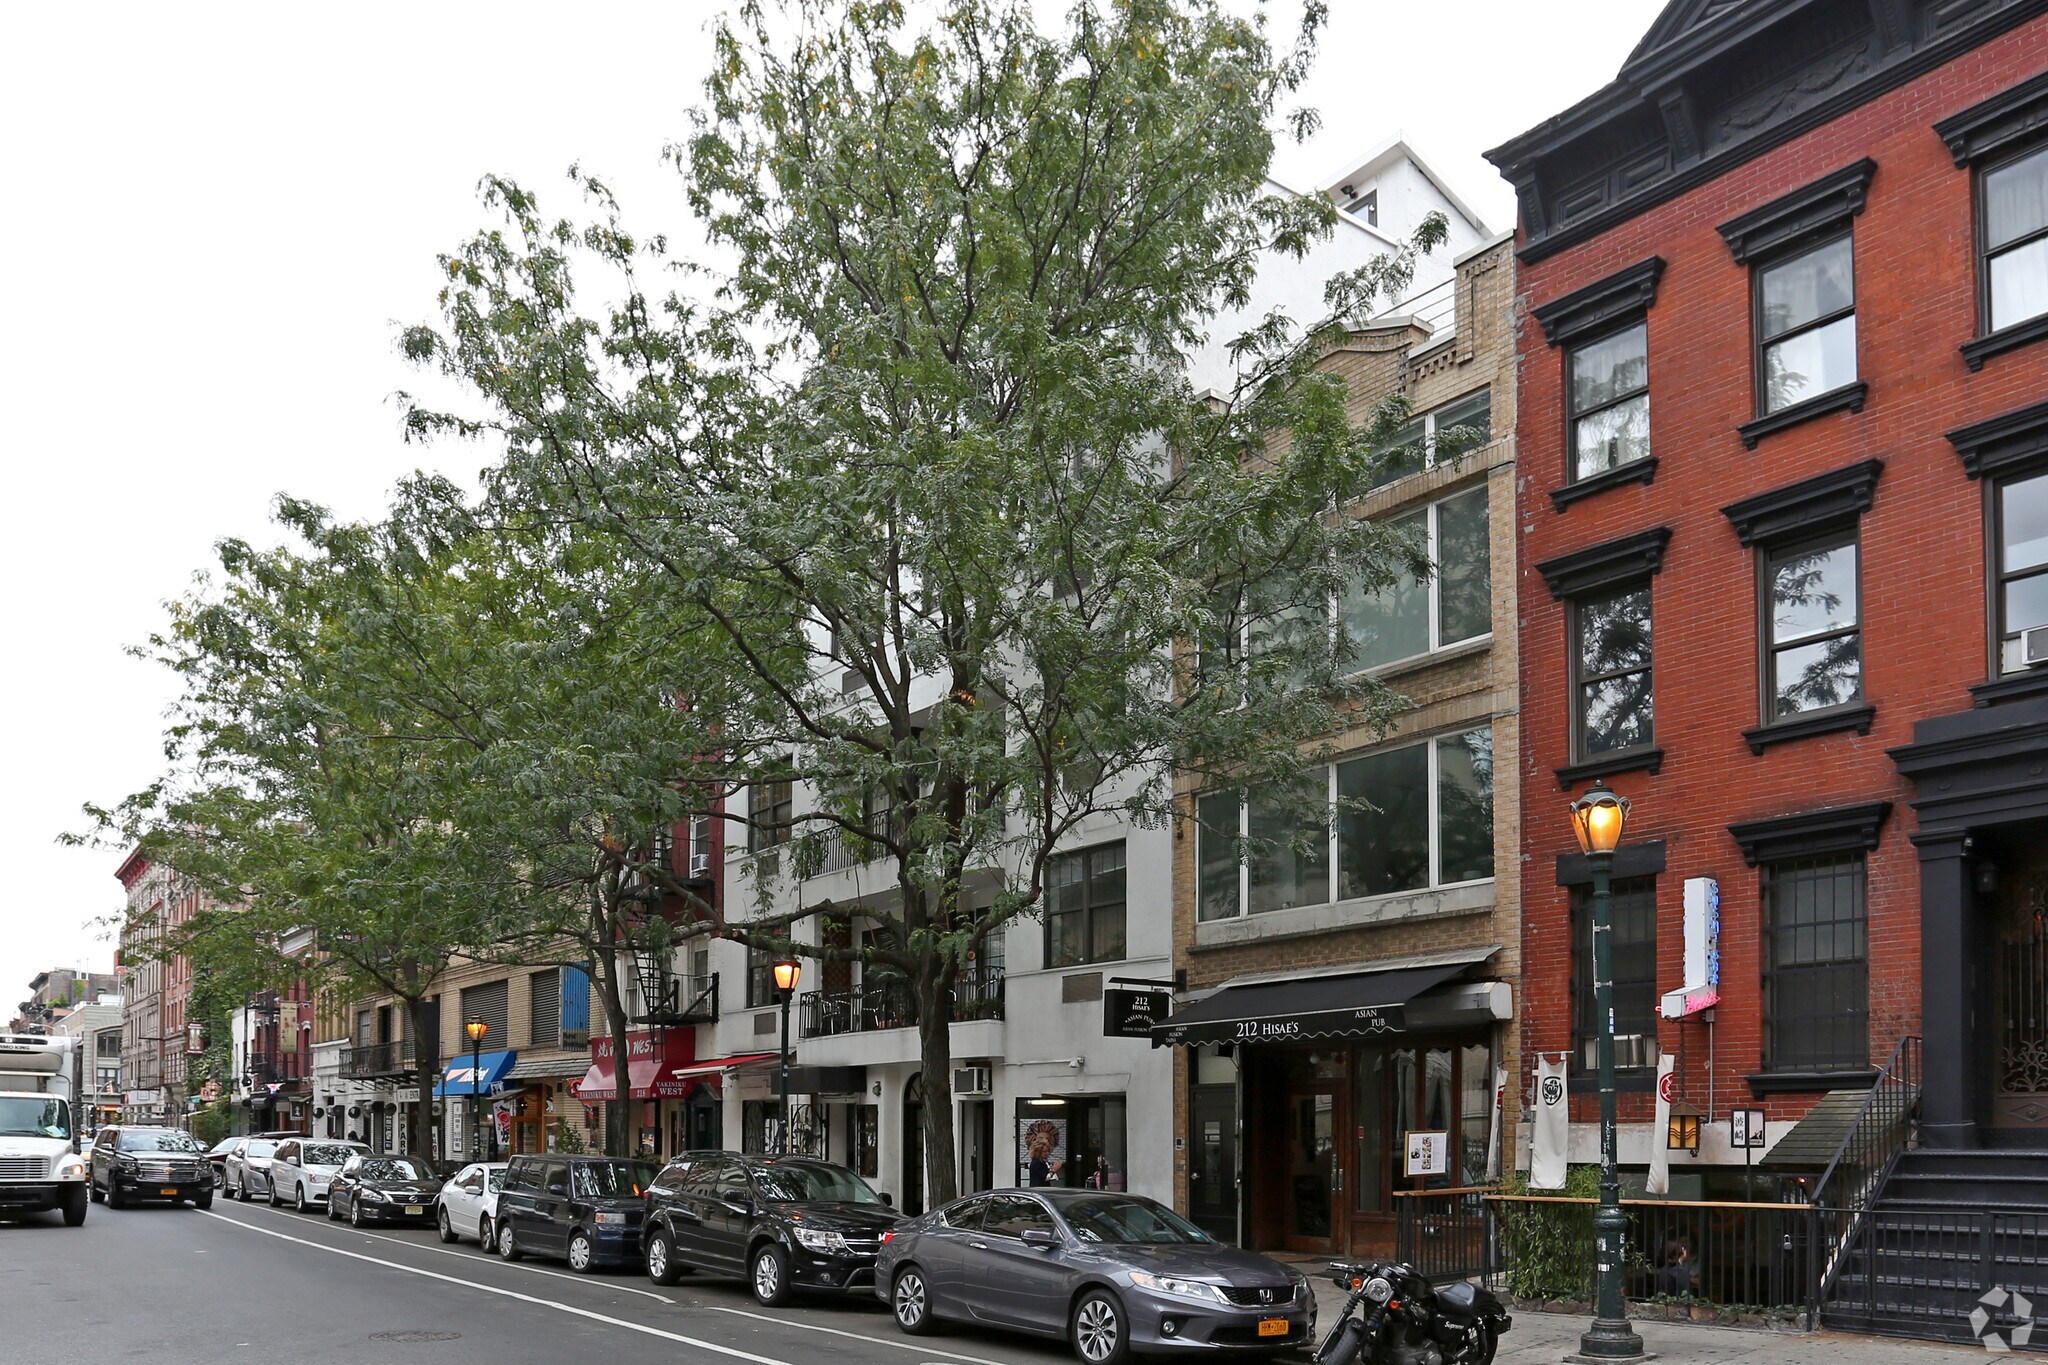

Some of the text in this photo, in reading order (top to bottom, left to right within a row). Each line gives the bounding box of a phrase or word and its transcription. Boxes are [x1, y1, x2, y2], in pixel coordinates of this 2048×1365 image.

[1135, 996, 1148, 1005] 212
[1355, 1009, 1377, 1019] ASIAN
[1371, 1018, 1385, 1027] PUB
[1236, 1021, 1299, 1037] 212 HISAE'S
[659, 1087, 683, 1096] WEST
